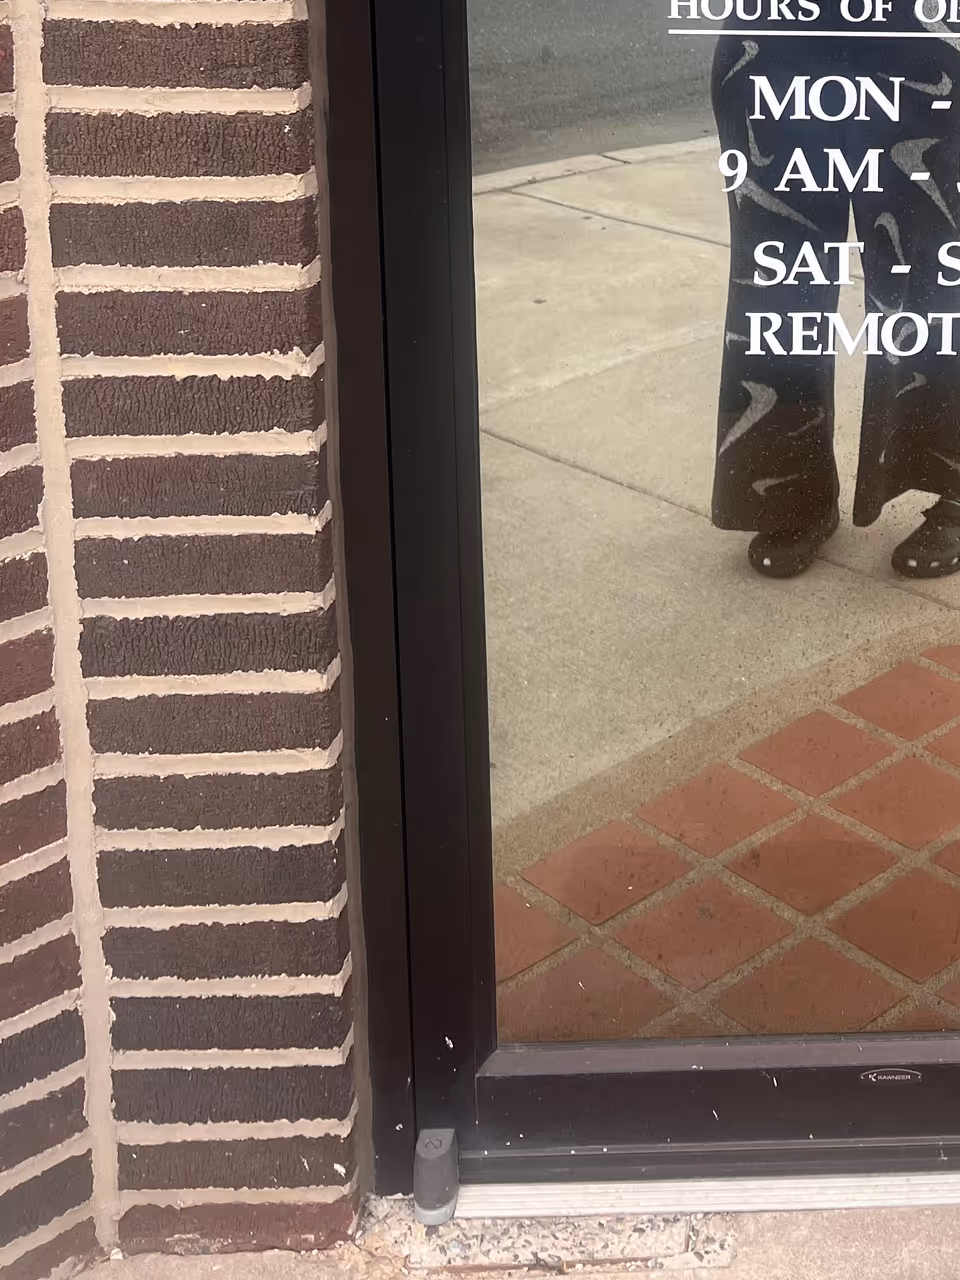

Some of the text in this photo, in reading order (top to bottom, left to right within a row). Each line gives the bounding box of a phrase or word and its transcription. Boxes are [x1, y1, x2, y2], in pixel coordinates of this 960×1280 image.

[749, 75, 905, 122] MON
[931, 100, 953, 110] -
[718, 148, 749, 193] 9
[774, 147, 884, 193] AM
[910, 171, 930, 181] -
[752, 240, 864, 286] SAT
[890, 265, 912, 274] -
